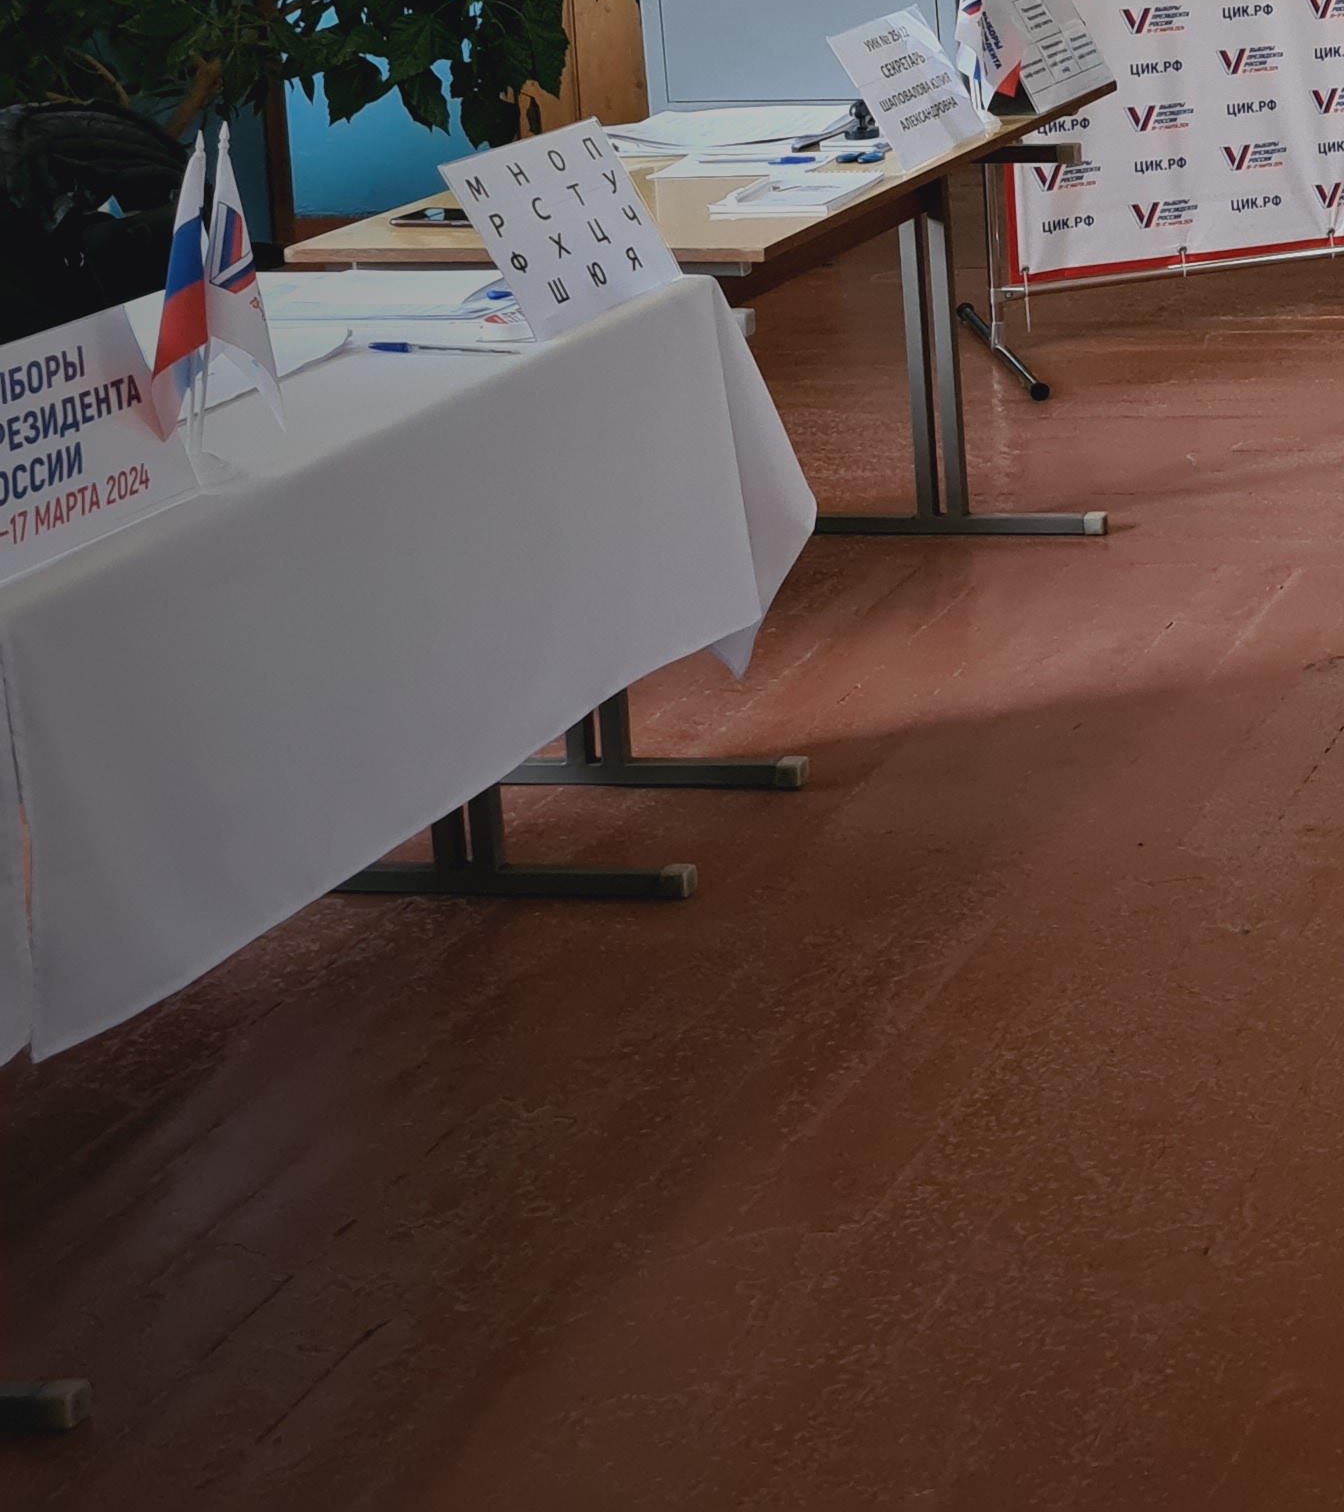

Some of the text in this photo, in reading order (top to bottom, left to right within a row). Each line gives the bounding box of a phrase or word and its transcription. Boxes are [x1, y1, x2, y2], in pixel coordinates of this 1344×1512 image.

[1223, 4, 1273, 21] ЦИК.РФ
[880, 51, 926, 79] СЕКРЕТАРЬ
[1130, 60, 1182, 77] ЦИК.РФ
[1227, 99, 1276, 117] ЦИК.РФ
[465, 137, 603, 202] М Н О П
[1135, 157, 1186, 174] ЦИК.РФ
[488, 170, 617, 238] Р С Т У
[1231, 195, 1281, 213] ЦИК.РФ
[1043, 215, 1094, 234] ЦИК.РФ
[510, 205, 642, 273] Ф Х Ц Ч
[547, 246, 644, 304] Ш Ю Я
[35, 482, 100, 536] МАРТА
[106, 463, 150, 506] 2024
